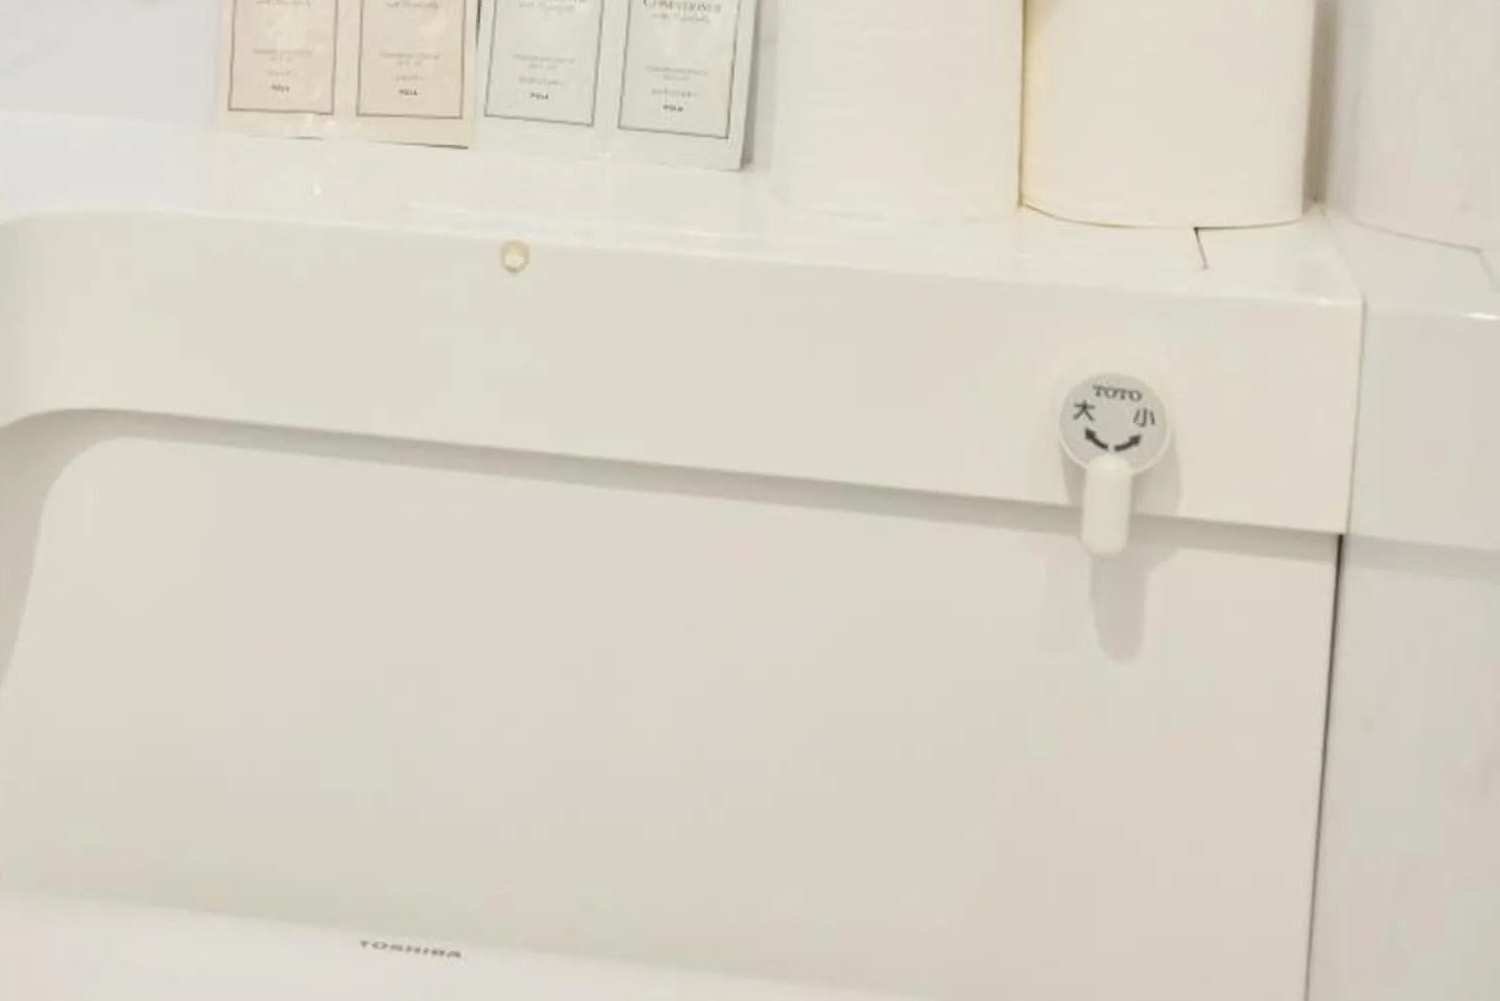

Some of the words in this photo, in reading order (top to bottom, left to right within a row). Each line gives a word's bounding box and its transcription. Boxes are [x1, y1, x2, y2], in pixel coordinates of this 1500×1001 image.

[1092, 384, 1143, 402] TOTO
[1073, 400, 1096, 421] 大
[1133, 407, 1155, 427] 小
[359, 940, 462, 959] TOSHIBA
